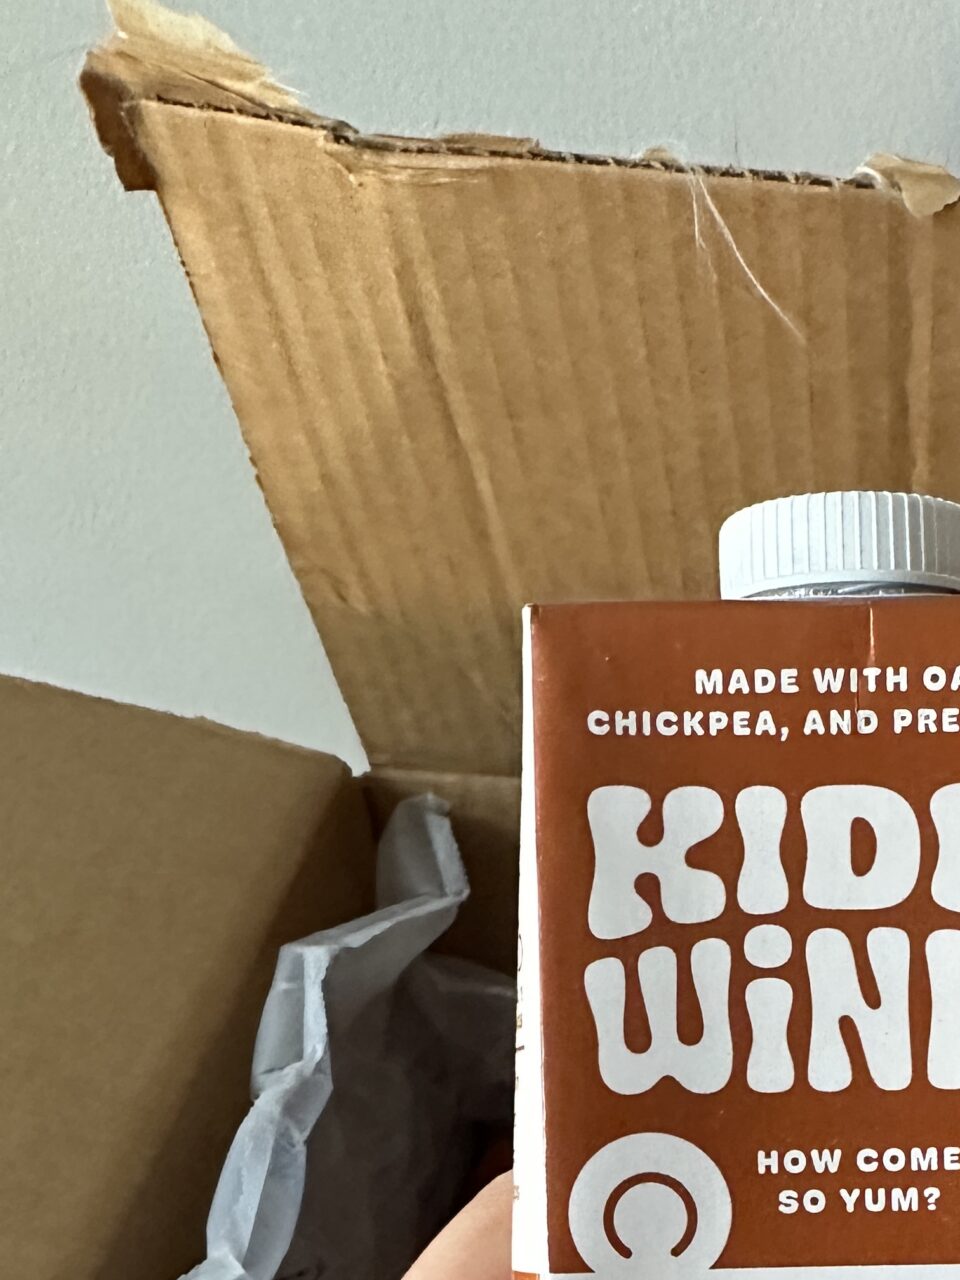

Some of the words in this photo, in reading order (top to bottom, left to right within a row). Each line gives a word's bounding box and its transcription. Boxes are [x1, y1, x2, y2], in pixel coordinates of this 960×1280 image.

[695, 668, 799, 694] MADE
[813, 667, 907, 693] WITH
[587, 710, 789, 741] CHICKPEA,
[804, 708, 878, 735] AND
[758, 1149, 841, 1174] HOW
[857, 1147, 960, 1172] COME
[779, 1189, 826, 1214] SO
[840, 1187, 940, 1212] YUM?
